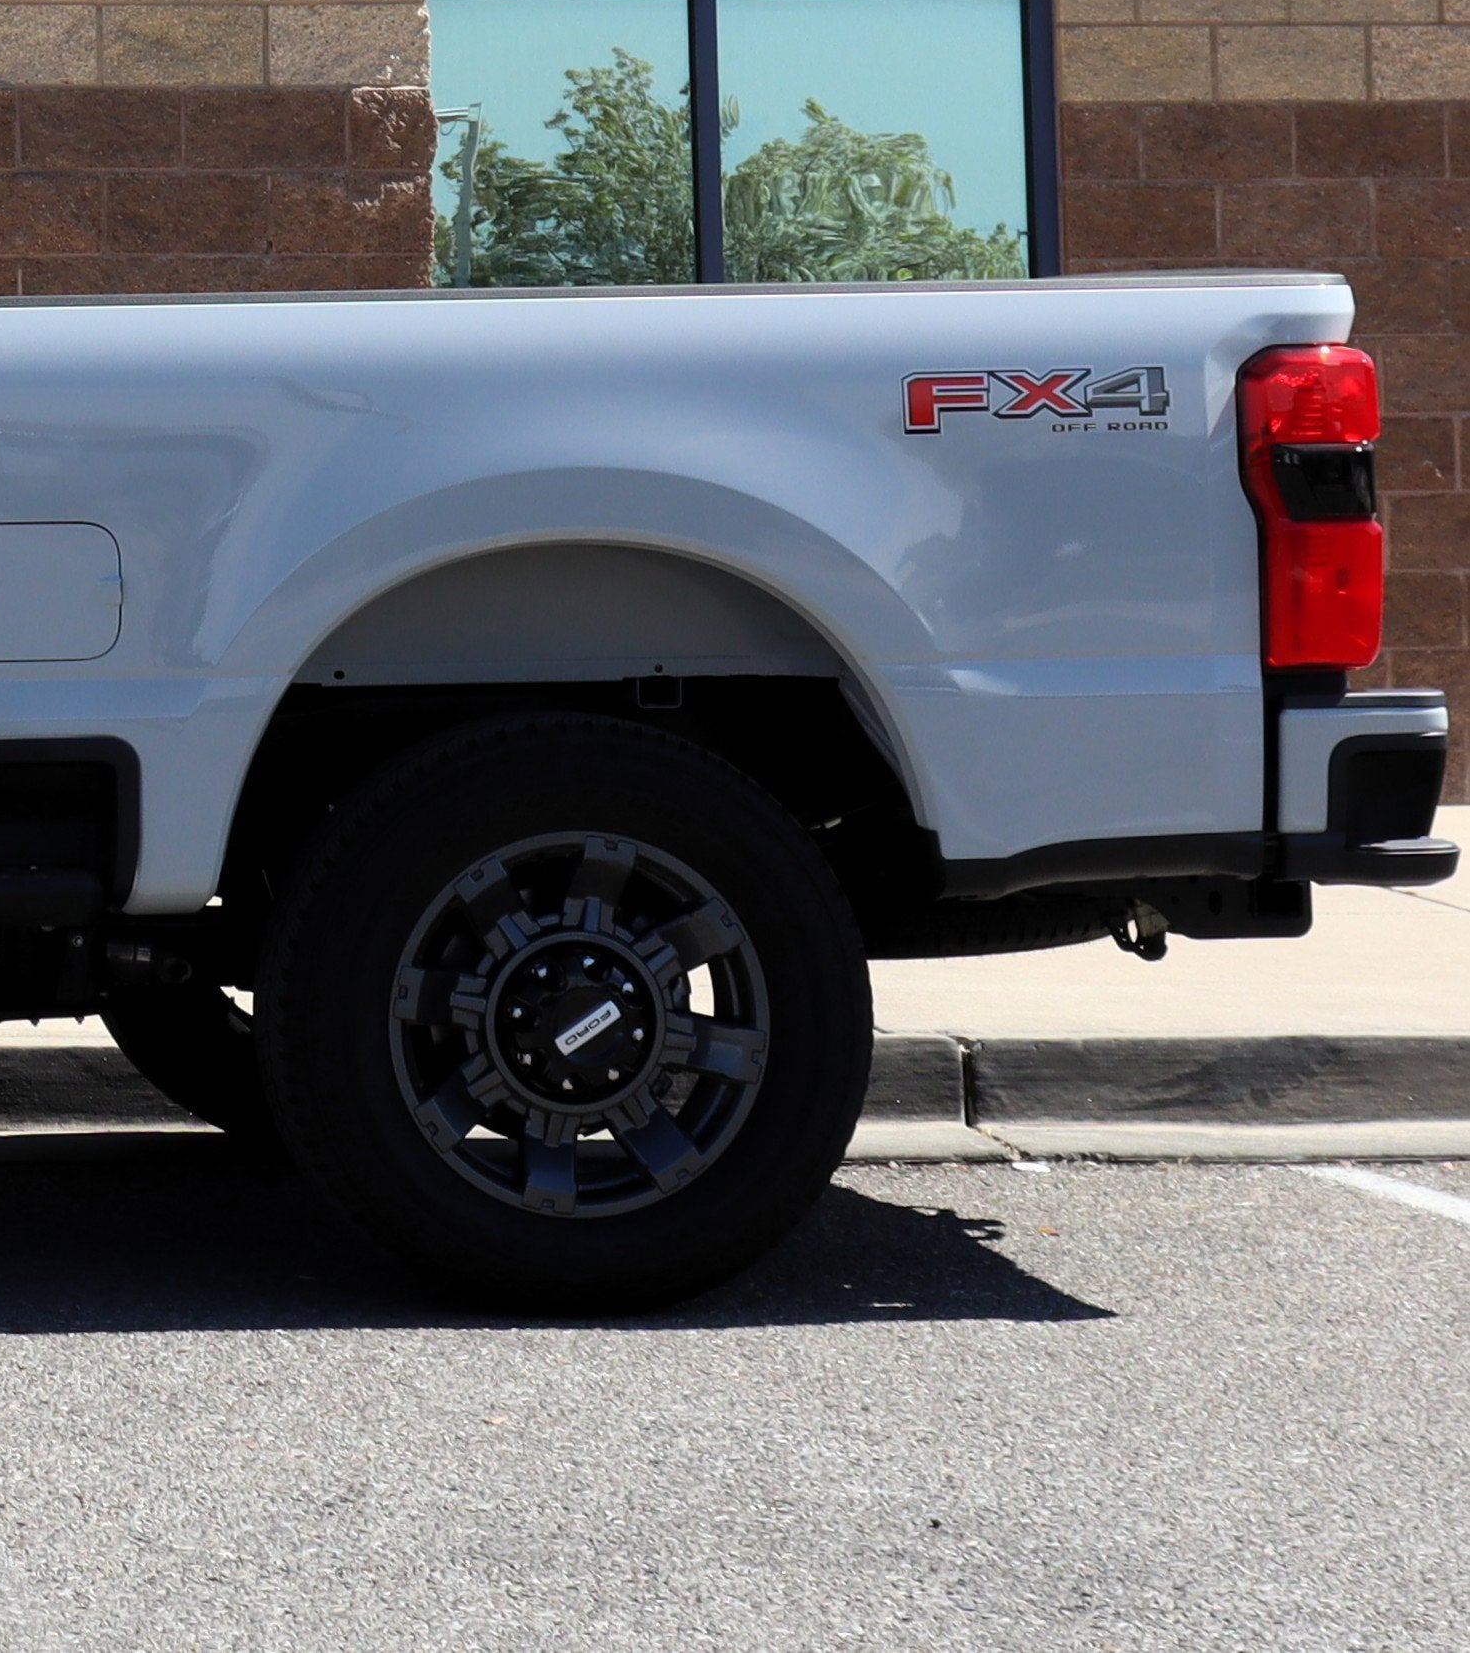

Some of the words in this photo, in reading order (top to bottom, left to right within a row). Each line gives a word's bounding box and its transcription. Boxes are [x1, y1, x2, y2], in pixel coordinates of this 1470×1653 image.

[901, 365, 1171, 434] FX4
[1051, 422, 1101, 433] OFF
[1107, 420, 1169, 432] ROAD
[564, 1009, 612, 1046] FORD
